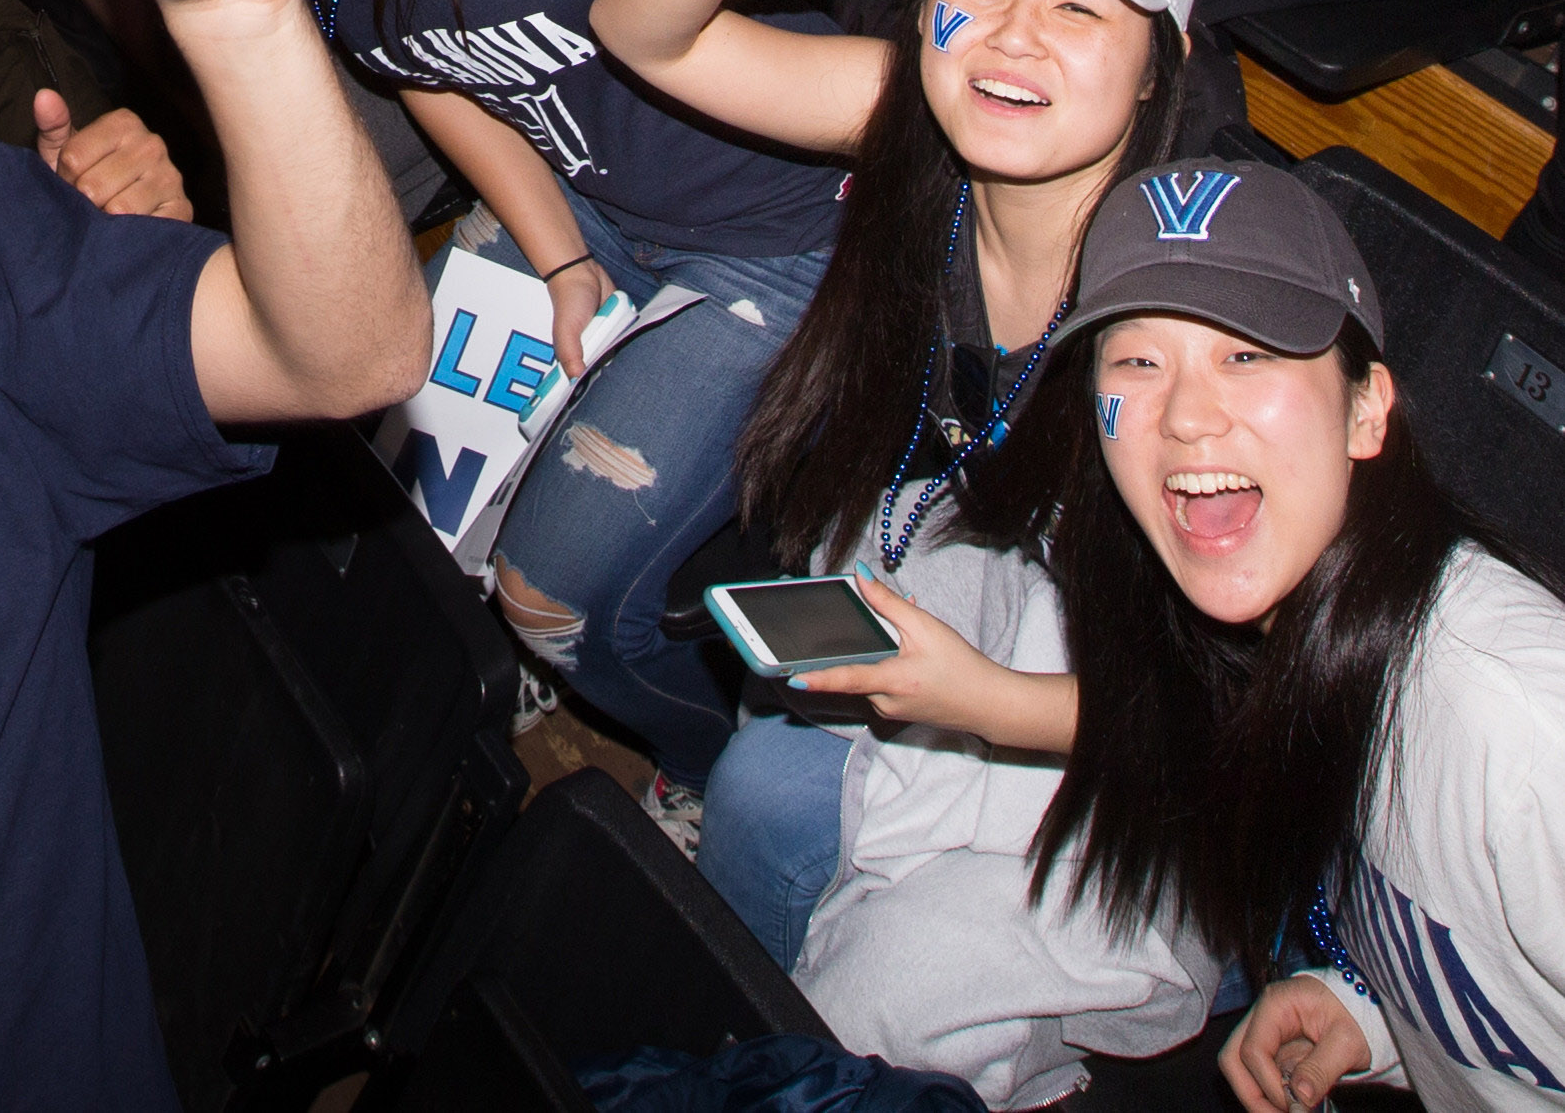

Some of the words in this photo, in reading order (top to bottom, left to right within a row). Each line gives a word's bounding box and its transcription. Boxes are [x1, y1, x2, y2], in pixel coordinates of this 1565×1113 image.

[932, 0, 976, 55] V
[1138, 170, 1243, 242] V
[1515, 362, 1553, 403] 13
[1095, 392, 1125, 440] V
